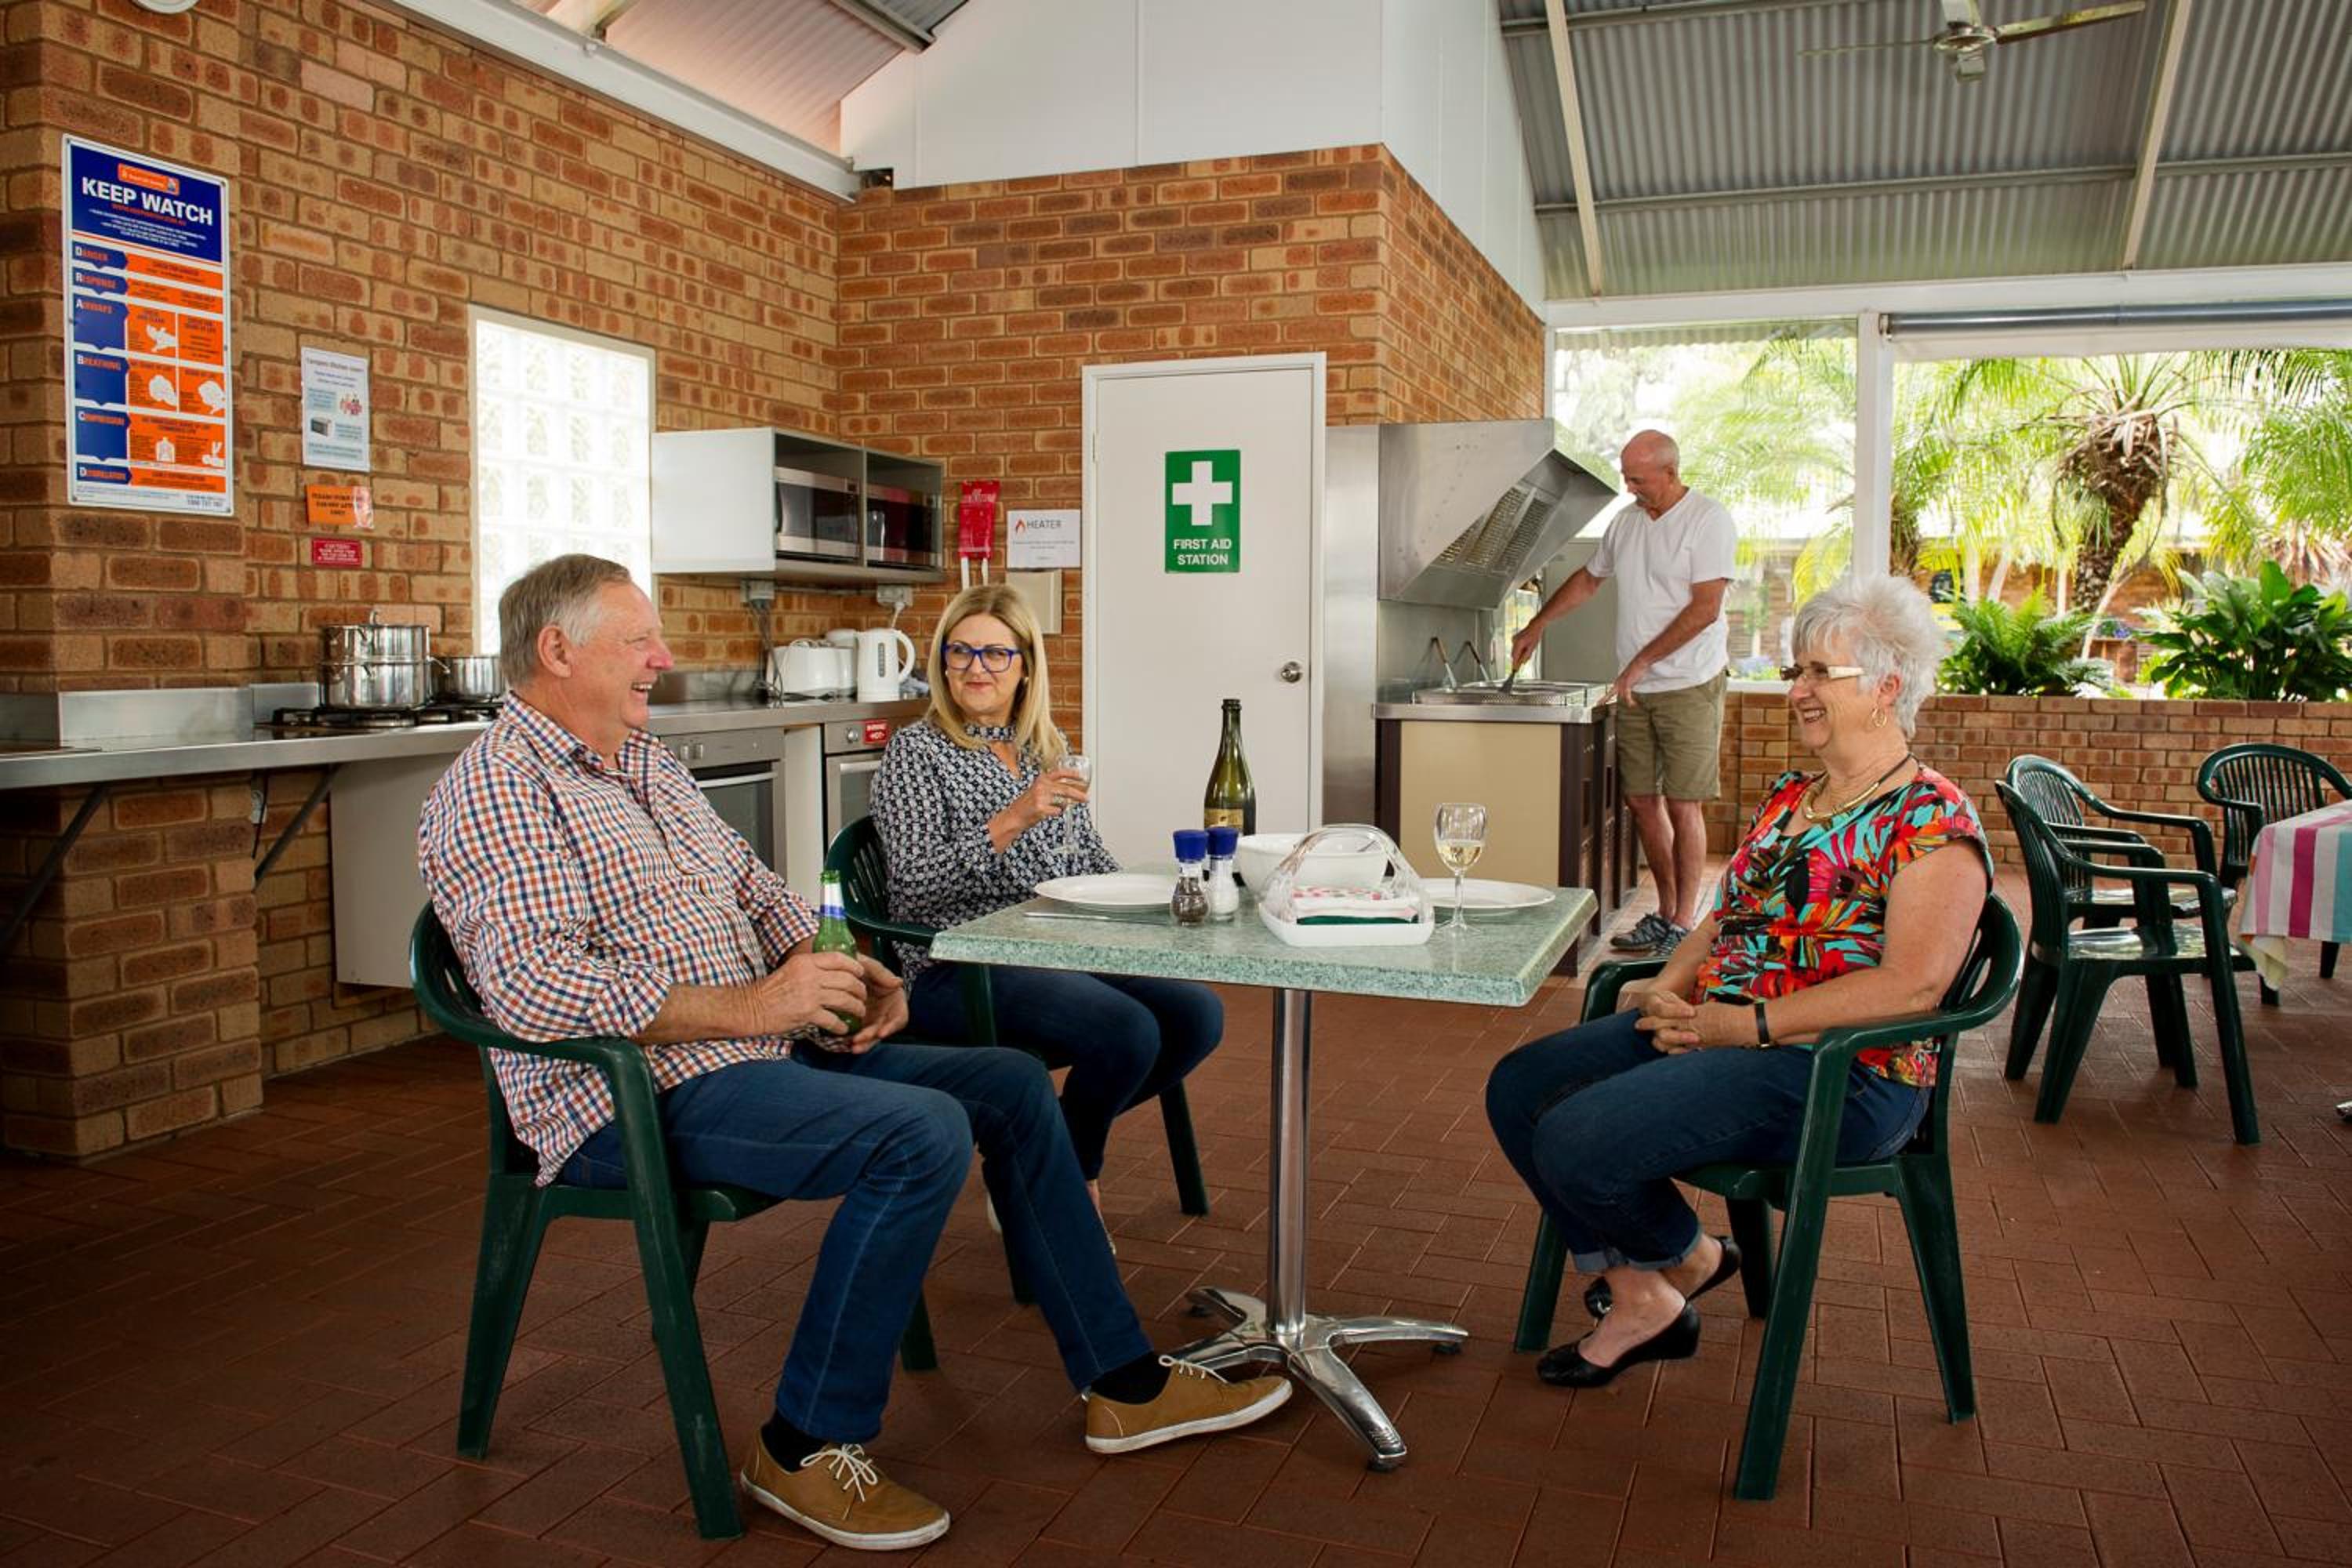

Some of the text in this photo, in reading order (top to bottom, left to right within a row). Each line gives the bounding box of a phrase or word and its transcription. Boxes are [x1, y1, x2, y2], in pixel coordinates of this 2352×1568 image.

[82, 176, 137, 205] KEEP
[141, 192, 212, 225] WATCH
[1027, 520, 1062, 529] HEATER
[1174, 539, 1232, 550] FIRST AID
[1178, 554, 1229, 565] STATION
